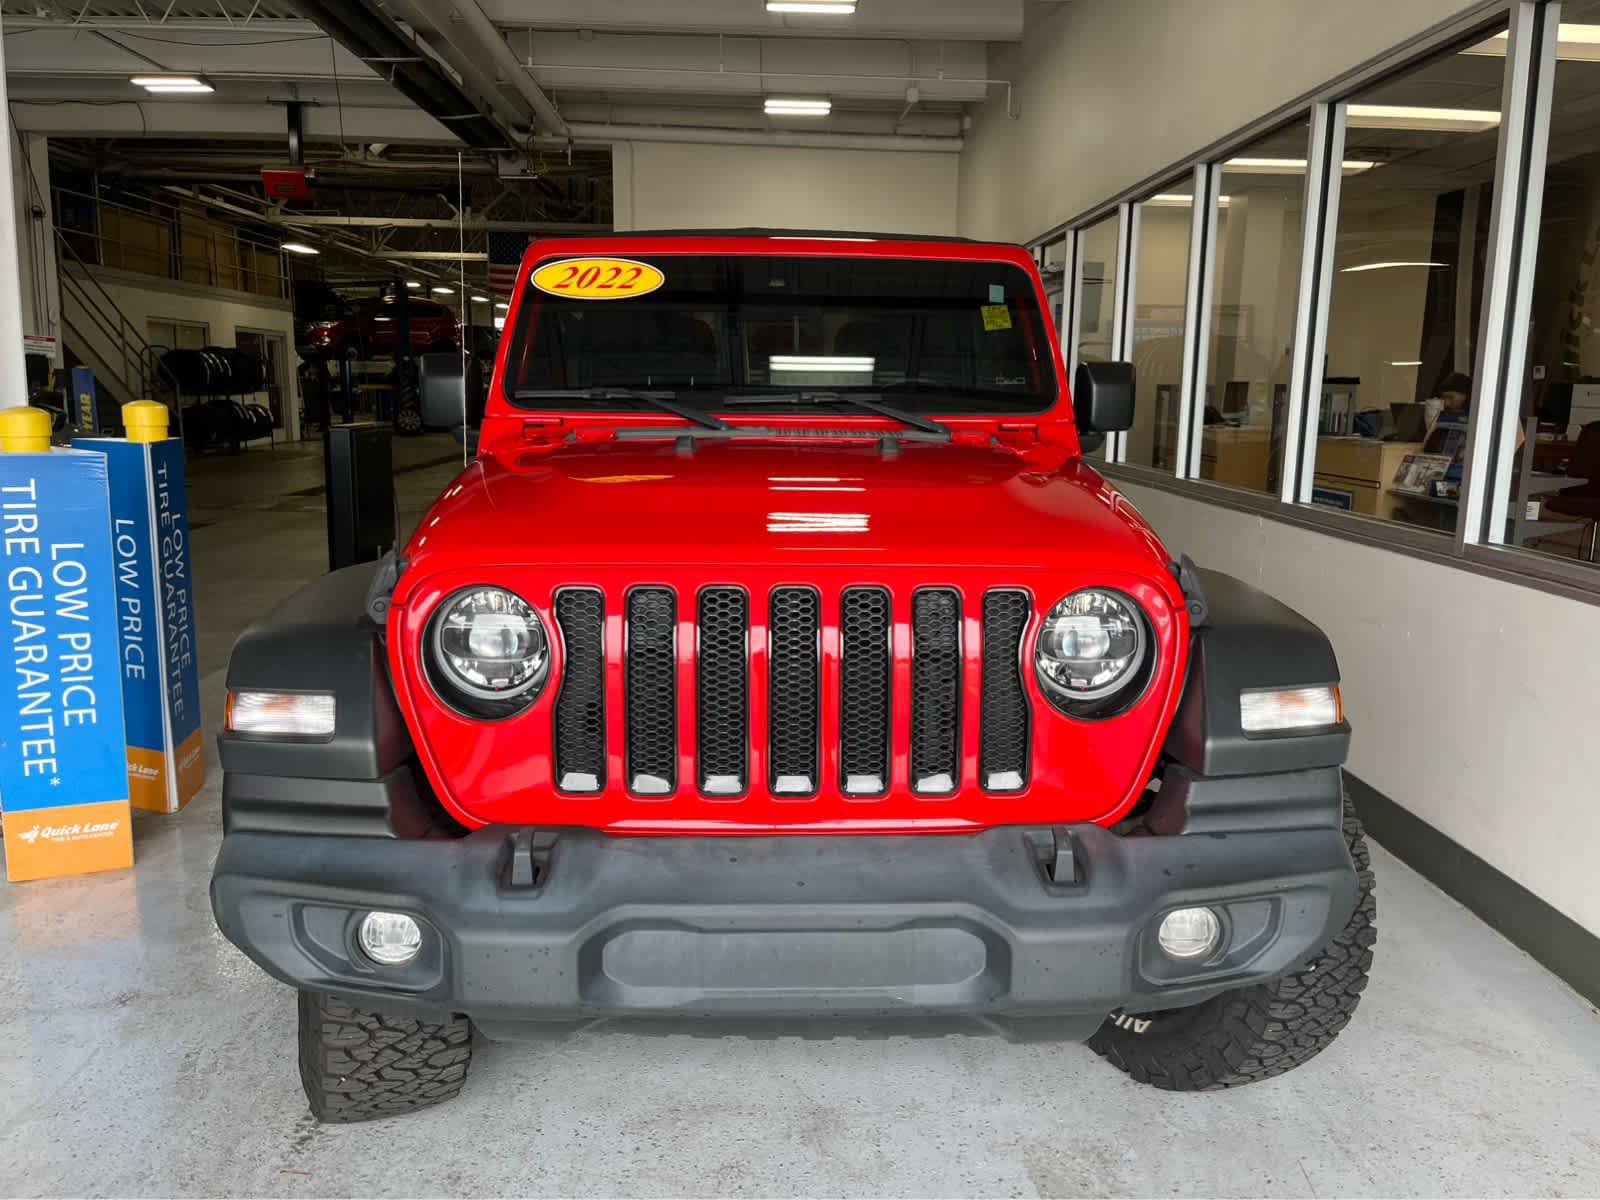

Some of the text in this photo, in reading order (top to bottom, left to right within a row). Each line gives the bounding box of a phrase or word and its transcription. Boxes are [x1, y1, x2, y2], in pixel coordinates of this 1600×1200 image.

[552, 266, 643, 289] 2022
[1, 478, 41, 556] TIRE
[158, 460, 171, 529] TIRE
[116, 518, 146, 680] LOW PRICE
[172, 513, 192, 669] LOW PRICE
[50, 543, 98, 728] LOW PRICE
[41, 823, 81, 840] Quick
[82, 821, 119, 833] Lane
